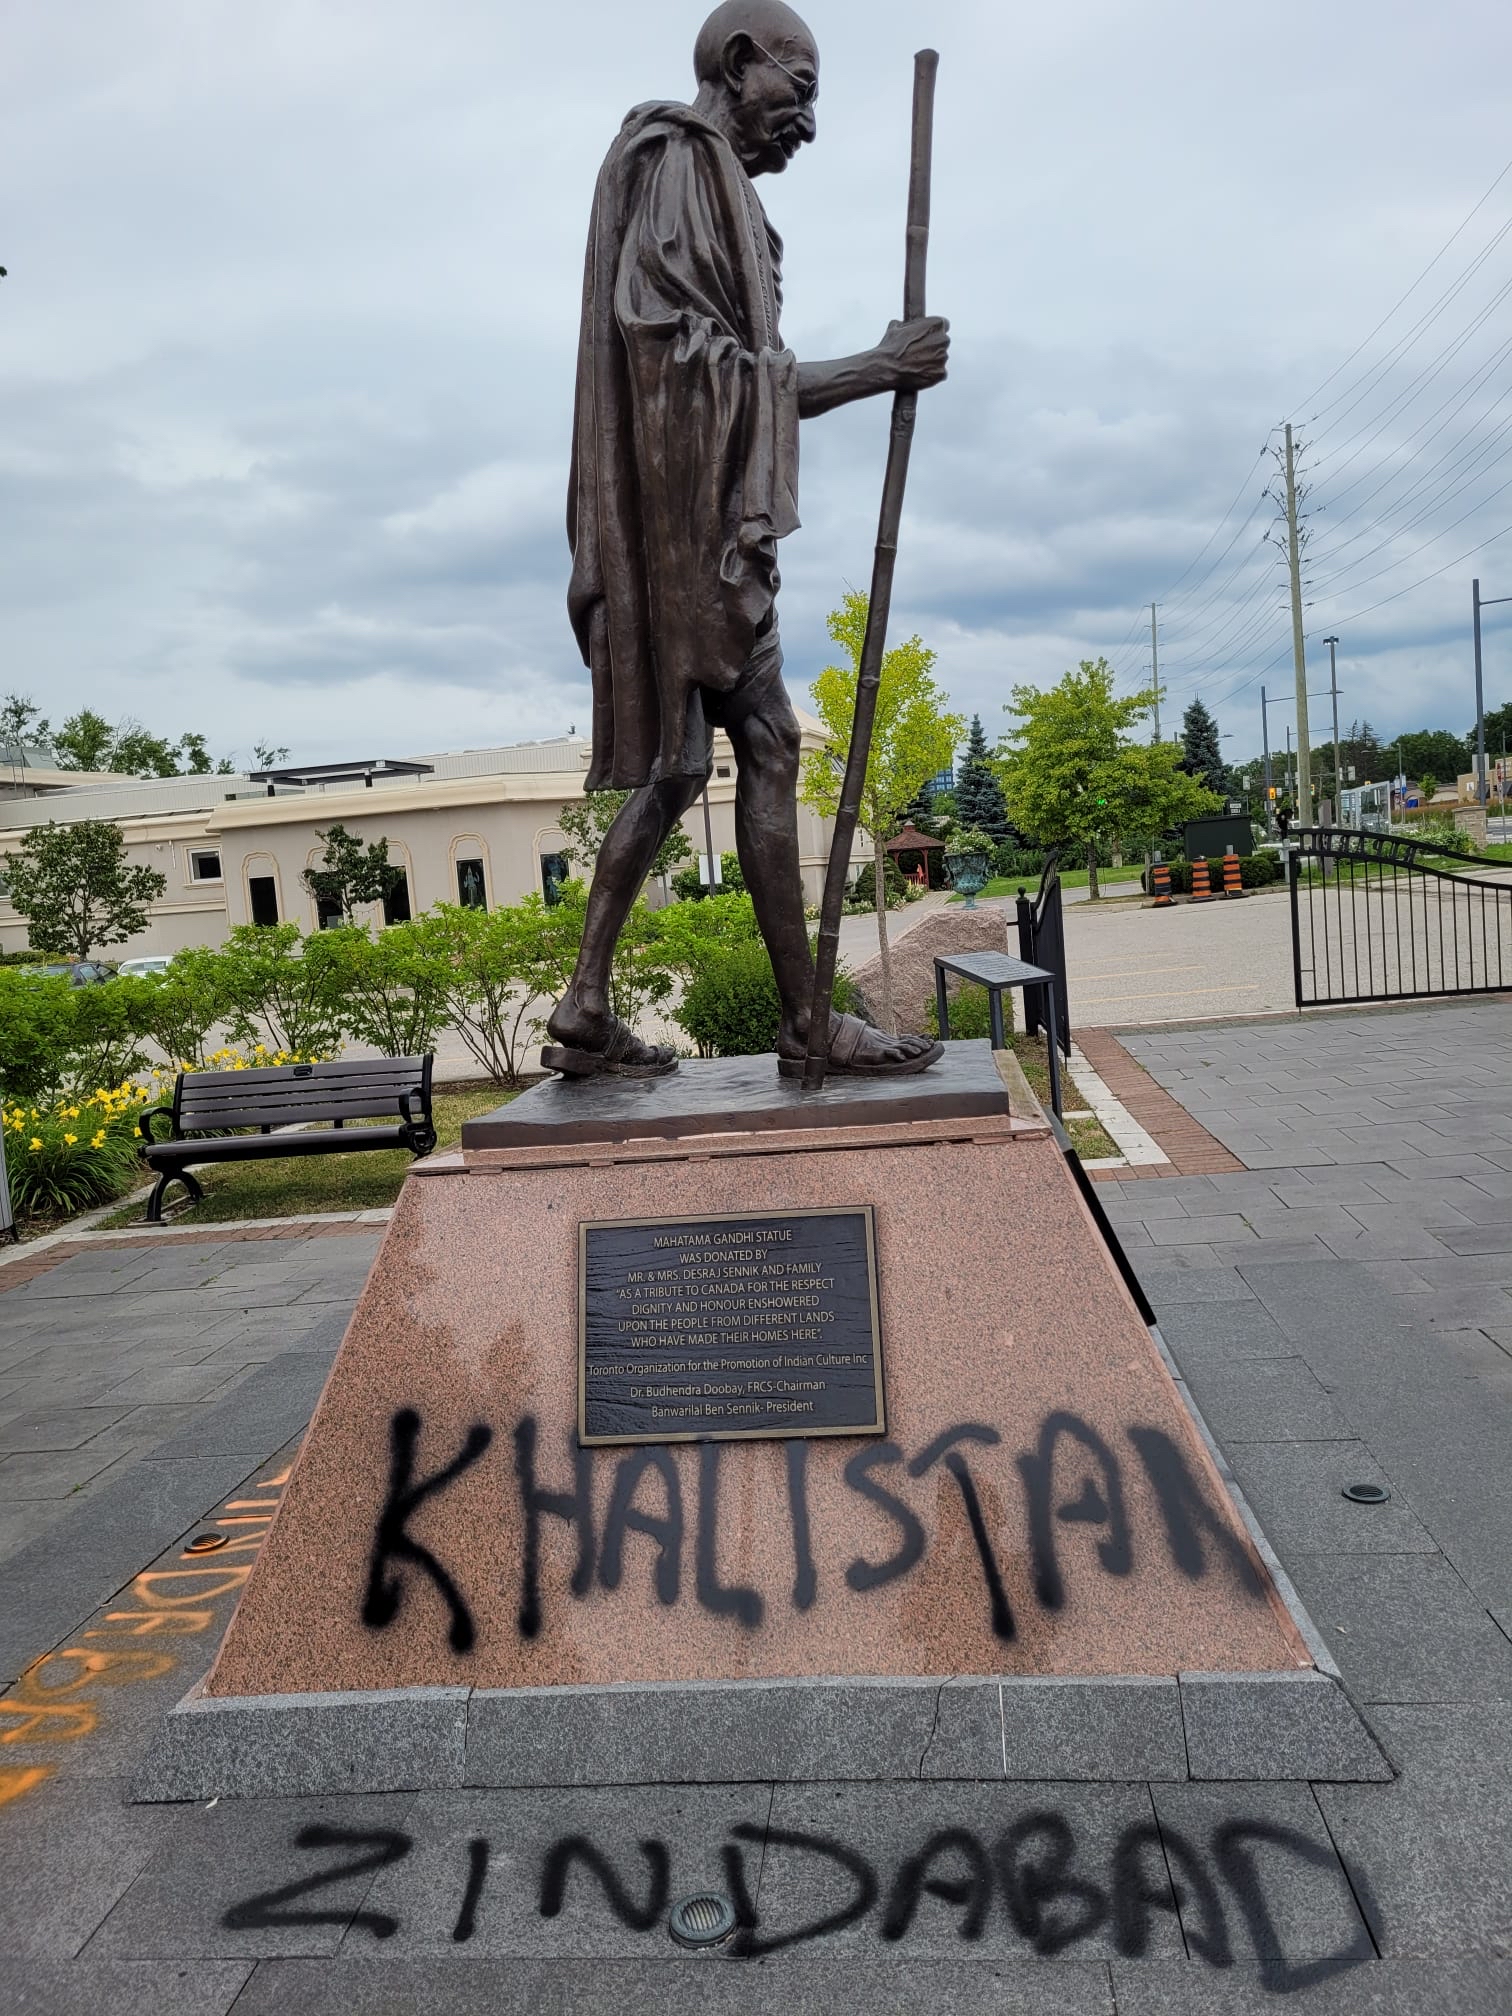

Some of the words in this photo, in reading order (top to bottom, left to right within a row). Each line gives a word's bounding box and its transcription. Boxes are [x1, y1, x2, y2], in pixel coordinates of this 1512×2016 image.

[654, 1234, 711, 1248] MAHATAMA
[713, 1231, 753, 1244] GANDHI
[756, 1230, 792, 1242] STATUE
[680, 1252, 702, 1264] WAS
[704, 1250, 752, 1263] DONATED
[755, 1249, 768, 1260] BY
[627, 1272, 645, 1283] MR.
[647, 1271, 655, 1282] &
[657, 1270, 681, 1281] MRS.
[683, 1268, 721, 1280] DESRAJ
[723, 1266, 759, 1278] SENNIK
[762, 1264, 784, 1276] AND
[786, 1262, 822, 1274] FAMILY
[634, 1288, 642, 1299] A
[643, 1286, 683, 1298] TRIBUTE
[685, 1285, 699, 1296] TO
[701, 1282, 745, 1295] CANADA
[748, 1282, 768, 1293] FOR
[769, 1280, 789, 1292] THE
[791, 1278, 835, 1290] RESPECT
[632, 1303, 673, 1315] DIGNITY
[675, 1301, 697, 1313] AND
[700, 1299, 746, 1312] HONOUR
[748, 1295, 820, 1309] ENSHOWERED
[618, 1320, 648, 1332] UPON
[650, 1319, 668, 1331] THE
[671, 1317, 709, 1329] PEOPLE
[711, 1315, 741, 1327] FROM
[743, 1312, 797, 1326] DIFFERENT
[799, 1311, 835, 1323] LANDS
[631, 1336, 657, 1348] WHO
[659, 1334, 686, 1347] HAVE
[688, 1333, 718, 1345] MADE
[720, 1332, 749, 1343] THEIR
[751, 1329, 789, 1342] HOMES
[589, 1365, 625, 1376] Toronto
[626, 1360, 686, 1377] Organization
[688, 1360, 700, 1371] for
[703, 1359, 718, 1370] the
[721, 1356, 770, 1370] Promotion
[773, 1355, 782, 1367] of
[784, 1355, 814, 1366] Indian
[816, 1353, 851, 1365] Culture
[853, 1353, 868, 1364] Inc
[630, 1387, 644, 1398] Dr.
[646, 1384, 700, 1397] Budhendra
[704, 1381, 745, 1395] Doobay,
[748, 1379, 826, 1393] FRCS-Chairman
[652, 1404, 702, 1418] Banwarilal
[705, 1403, 724, 1415] Ben
[766, 1399, 814, 1413] President
[361, 1407, 1270, 1655] KHALISTAN
[220, 1812, 1382, 1996] ZINDABAD
